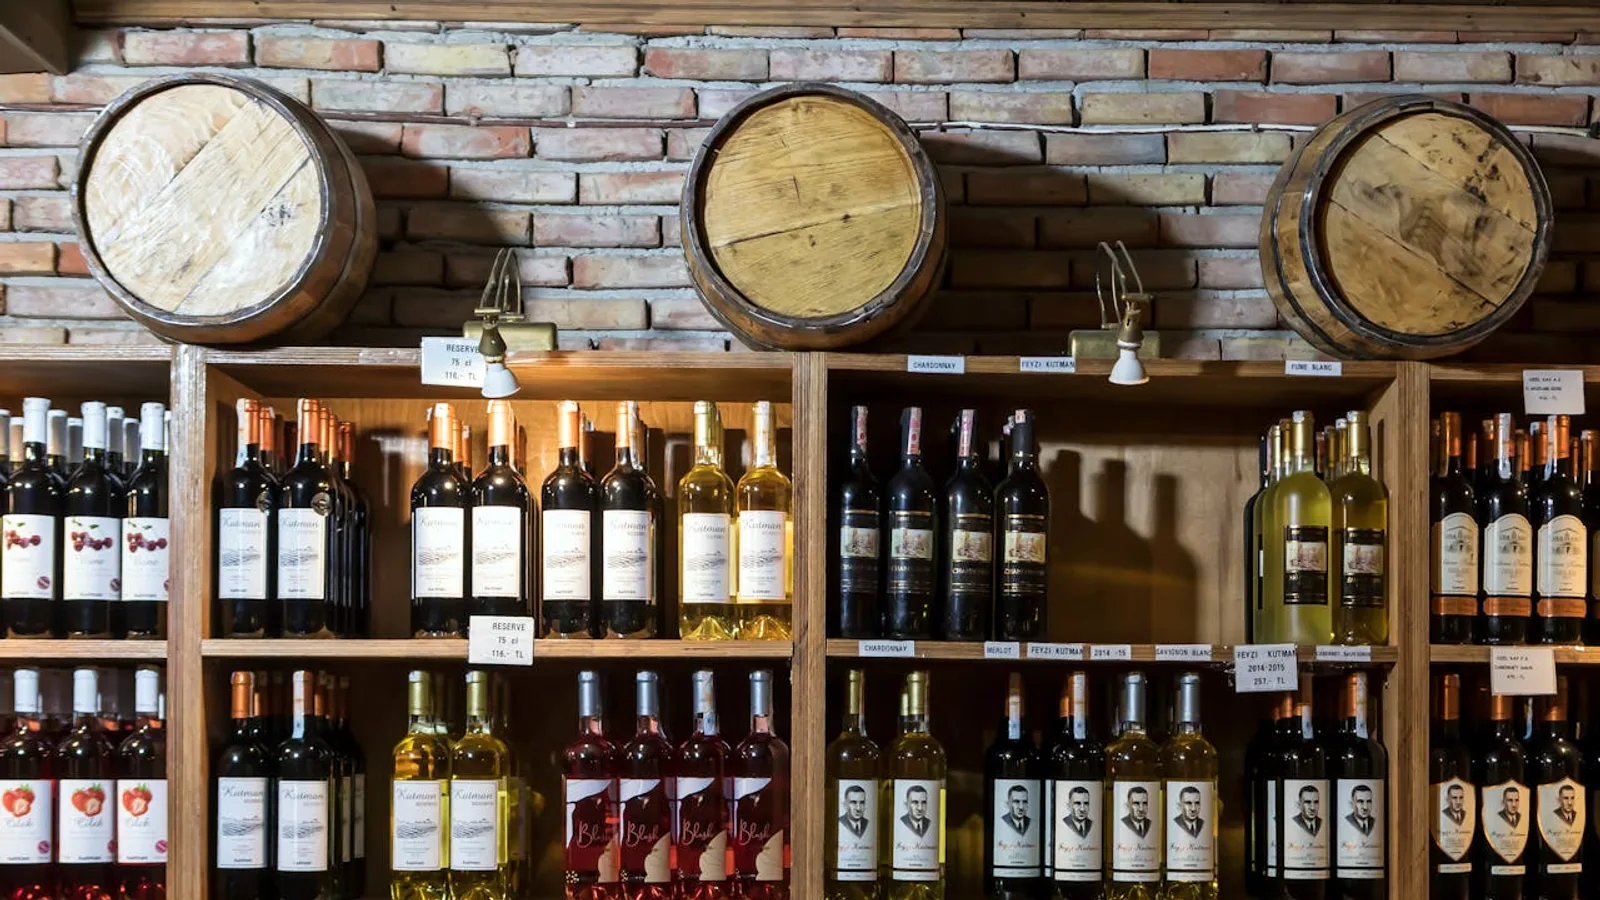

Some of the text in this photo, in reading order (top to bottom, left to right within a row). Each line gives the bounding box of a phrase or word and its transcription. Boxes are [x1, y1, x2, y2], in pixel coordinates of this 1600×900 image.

[446, 343, 481, 353] RESERVE
[452, 357, 460, 366] 75
[913, 361, 956, 369] CHARDONNAY
[468, 372, 477, 381] TL
[492, 622, 526, 631] RESERVE
[498, 636, 519, 645] 75 cl
[864, 644, 908, 652] CHARDONNAY
[986, 647, 1012, 655] MERLOT
[1031, 646, 1083, 655] FEYZI KUTMAN
[516, 649, 525, 659] TL
[1237, 650, 1258, 659] FEYZI
[1247, 663, 1287, 672] 2014-2015
[1277, 677, 1286, 685] TL
[223, 785, 265, 798] Kutman
[282, 789, 323, 800] Kutman
[397, 788, 437, 801] Kutman
[453, 788, 494, 800] Kutman
[626, 819, 661, 848] Blush
[681, 818, 718, 847] Blush
[739, 818, 771, 847] Blush
